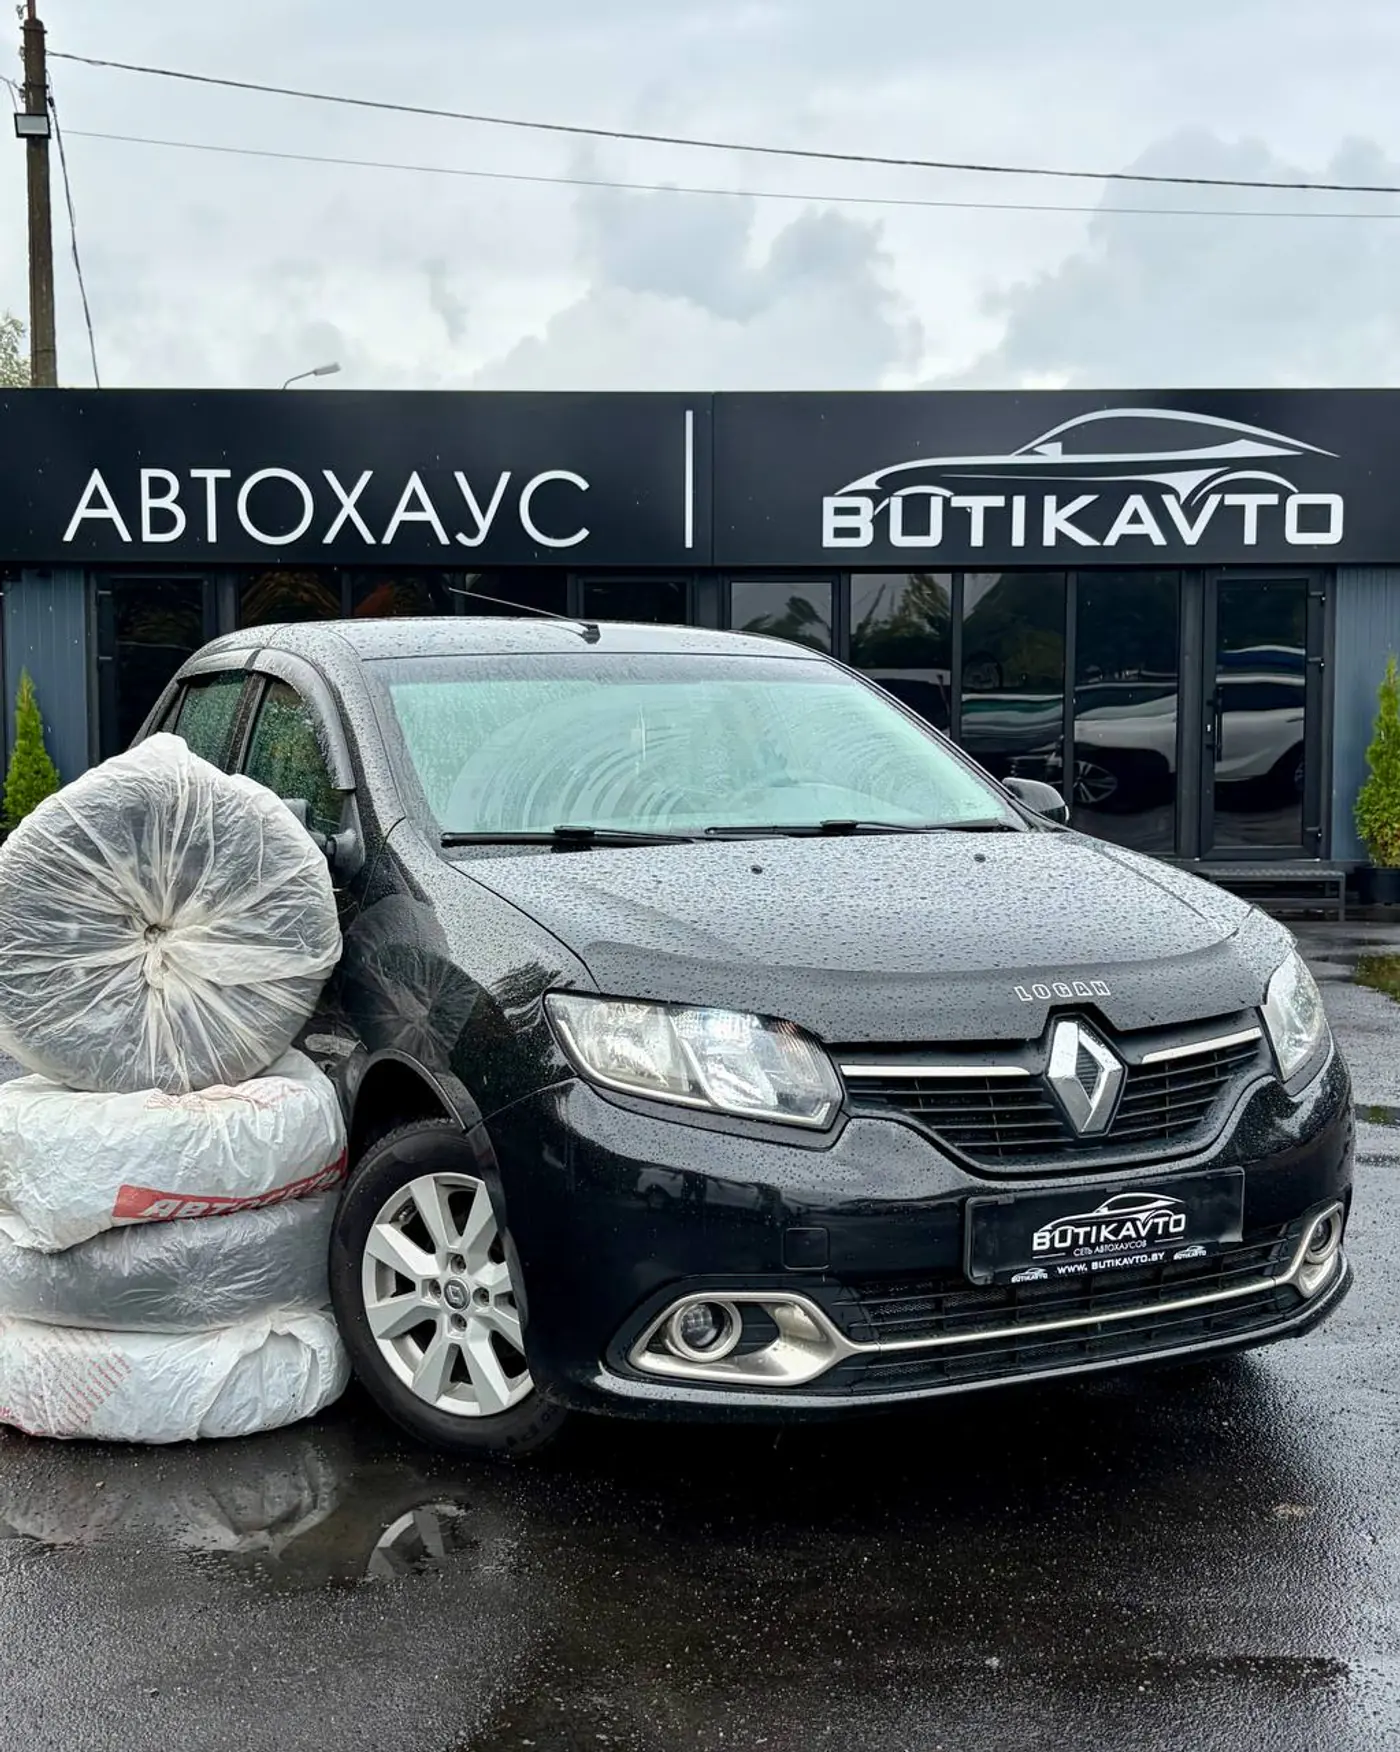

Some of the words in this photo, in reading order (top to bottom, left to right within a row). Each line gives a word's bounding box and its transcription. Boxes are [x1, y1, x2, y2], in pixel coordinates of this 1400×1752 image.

[62, 467, 590, 548] АВТОХАУС
[822, 492, 1344, 548] BUTIKAVTO
[1013, 980, 1112, 1002] LOGAN
[1032, 1212, 1186, 1251] BUTIKAVTO
[1073, 1246, 1093, 1257] СЕТЬ
[1094, 1240, 1147, 1254] АВТОХАУСОВ
